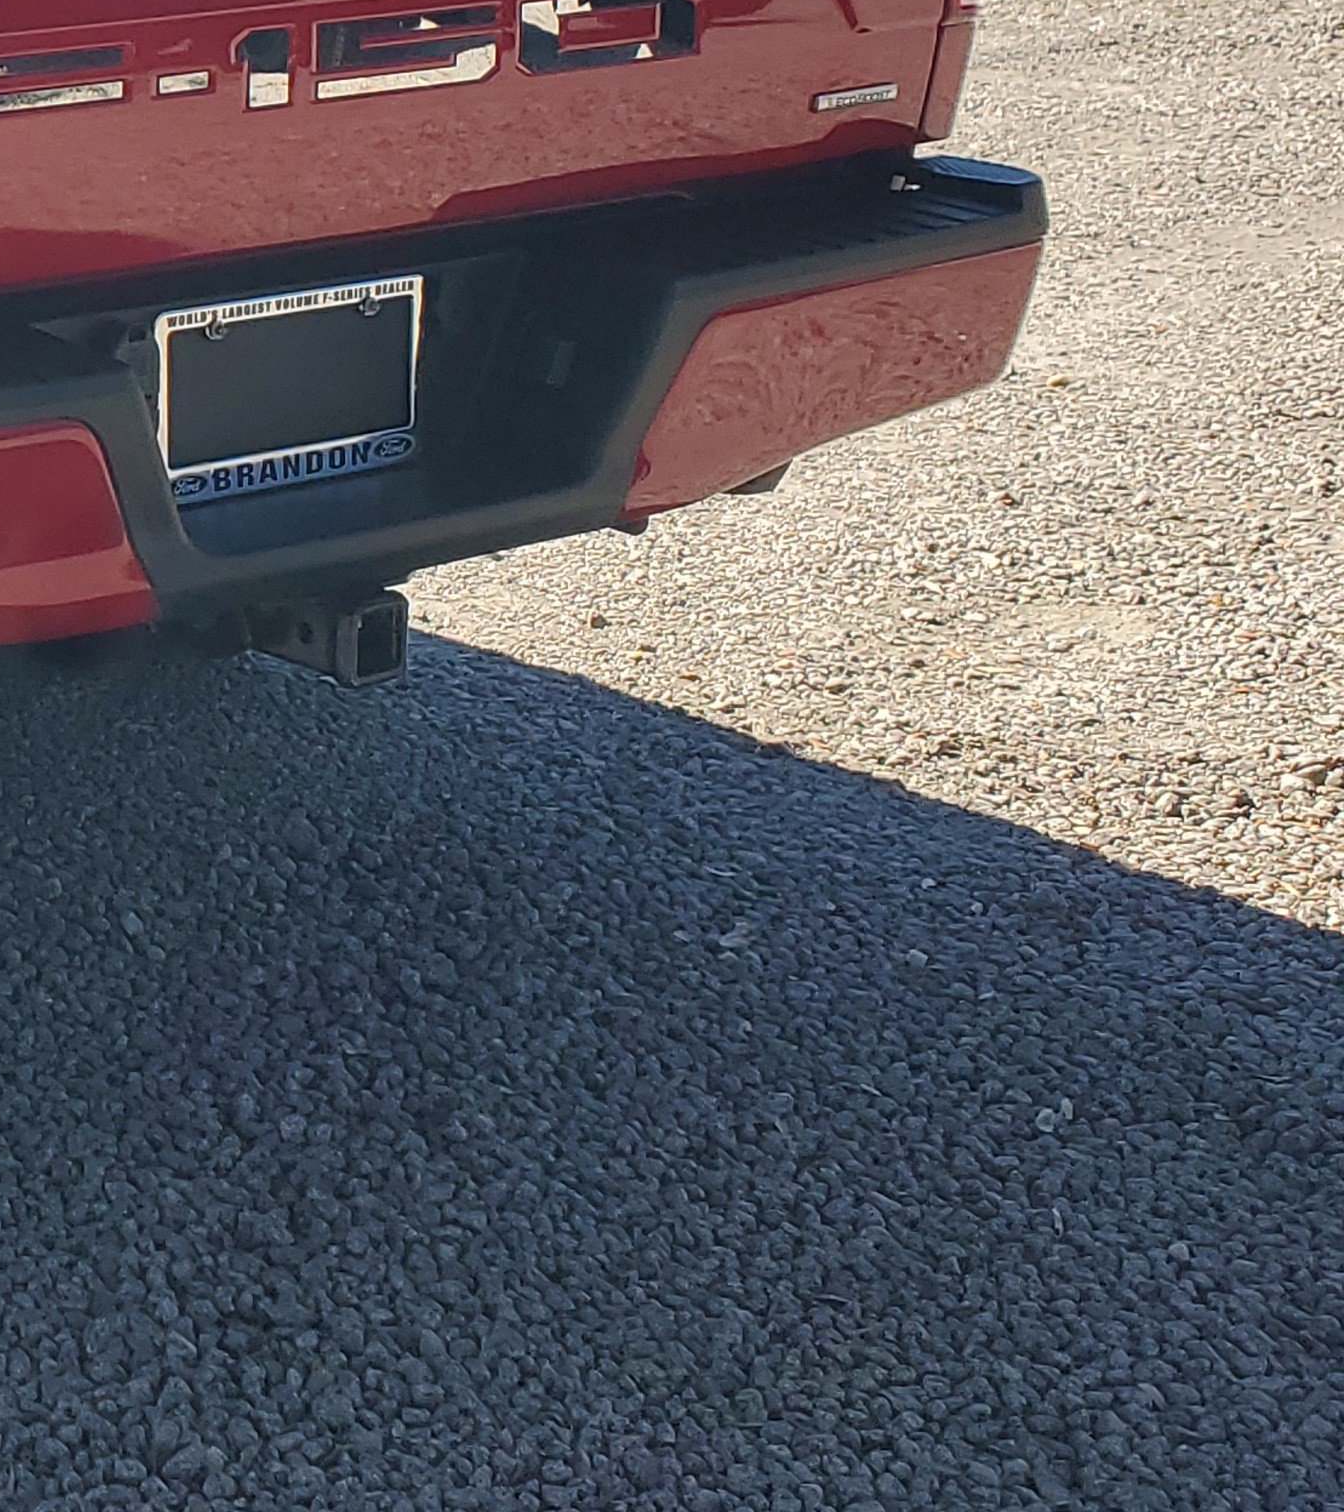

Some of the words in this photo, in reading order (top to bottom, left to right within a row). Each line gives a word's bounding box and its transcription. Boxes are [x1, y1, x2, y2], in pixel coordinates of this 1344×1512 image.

[166, 310, 218, 328] WORLD'S
[222, 300, 272, 320] LARGEST
[275, 292, 319, 311] VOLUME
[322, 286, 371, 304] F-SERIES
[375, 279, 415, 296] DEALER
[212, 441, 371, 493] BRANDON
